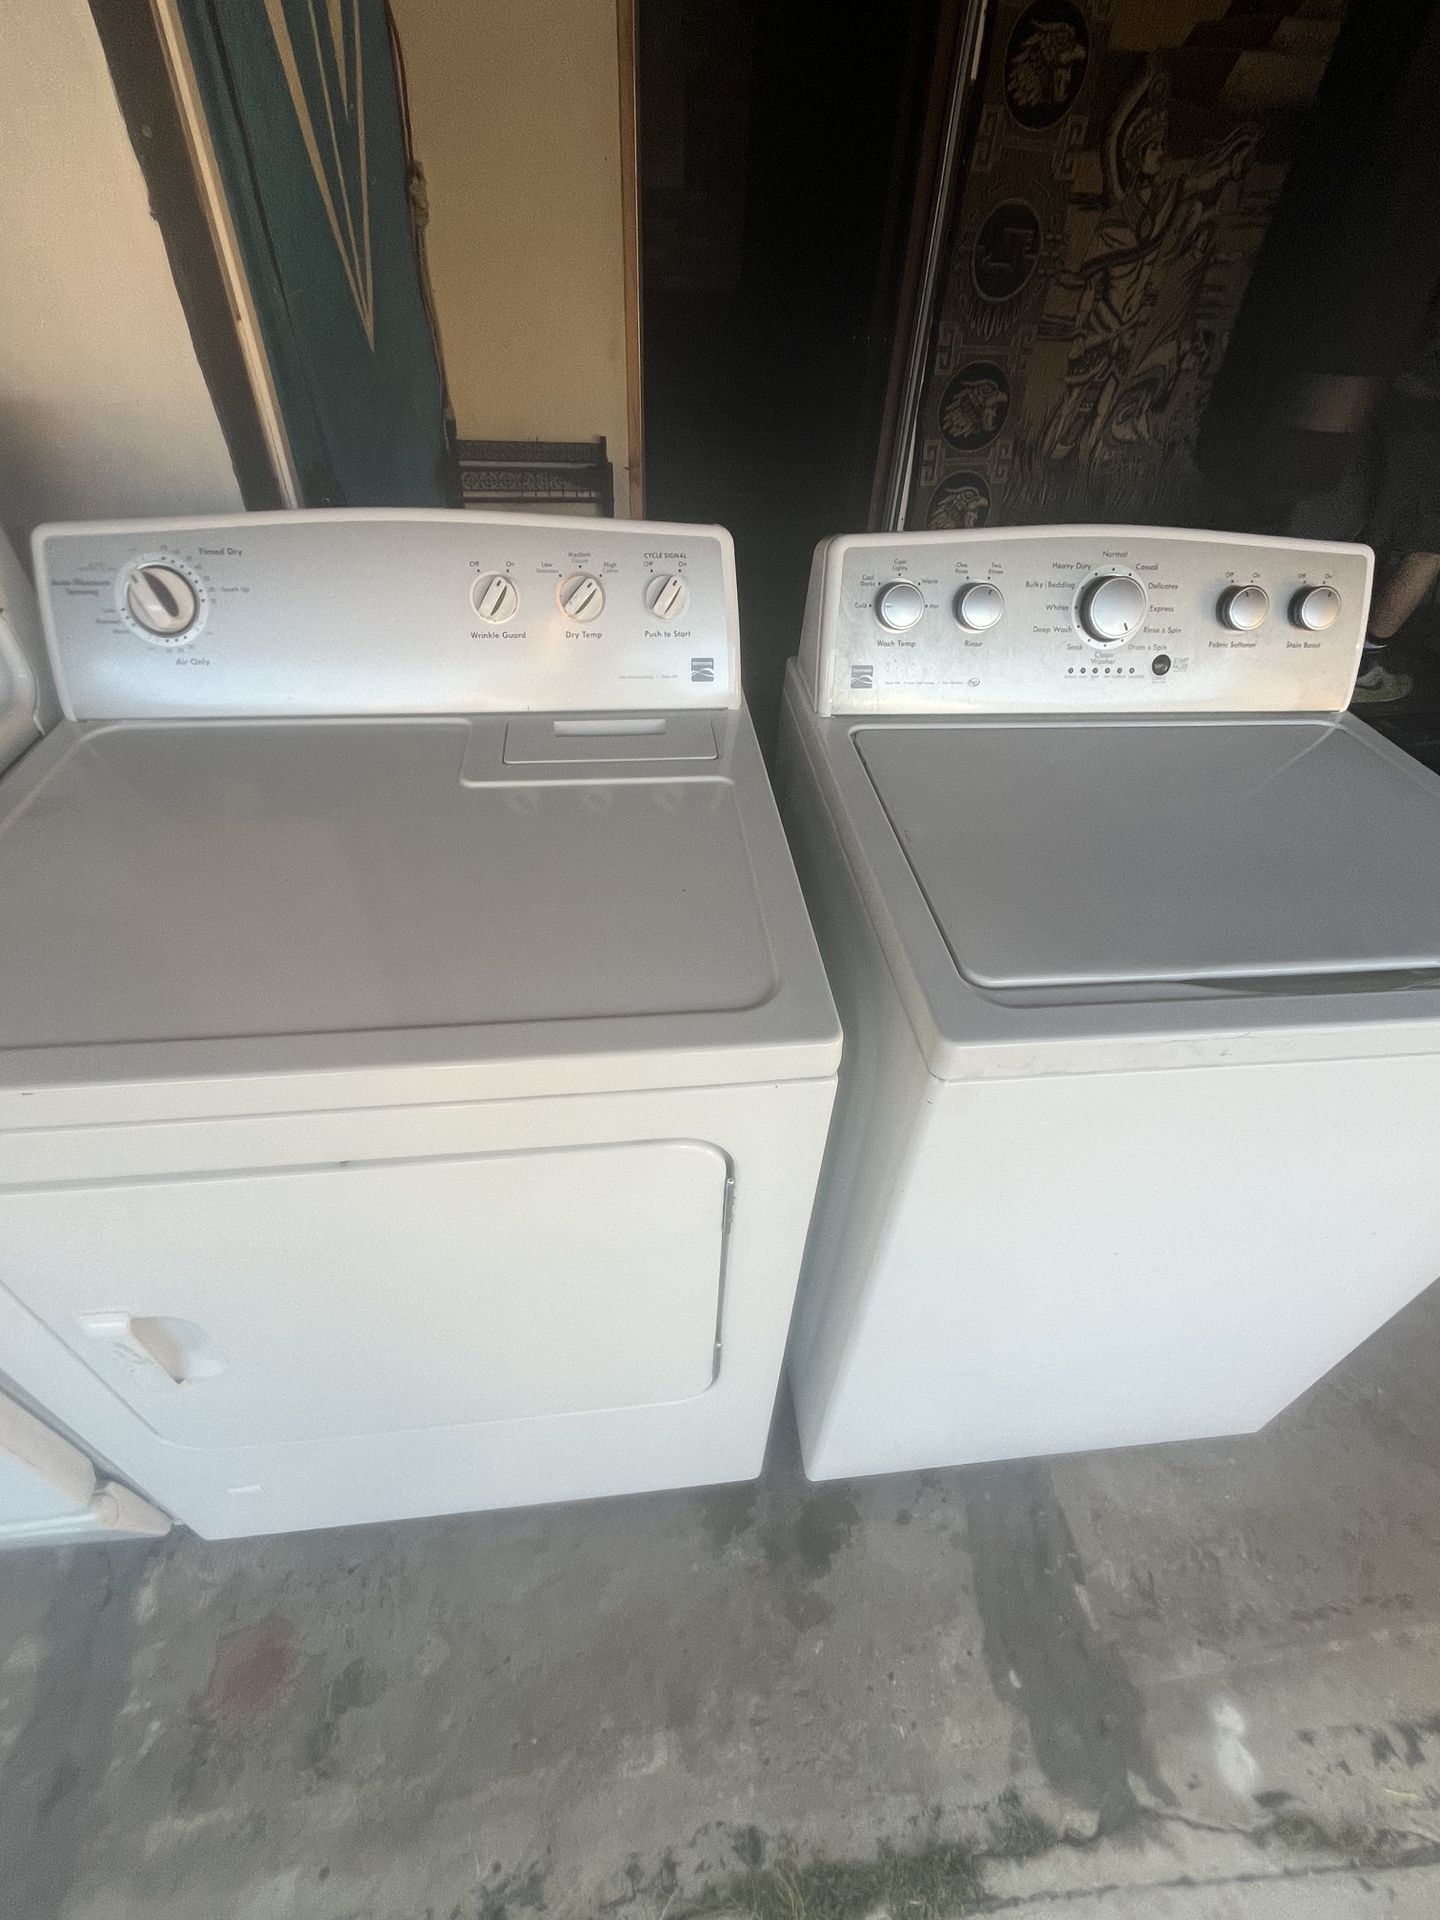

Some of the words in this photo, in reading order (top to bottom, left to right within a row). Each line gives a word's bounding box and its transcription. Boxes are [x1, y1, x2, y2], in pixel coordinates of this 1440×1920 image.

[199, 547, 225, 556] Timed
[227, 547, 243, 557] Dry
[1052, 562, 1073, 570] Heavy
[1076, 562, 1092, 570] Duty
[1135, 563, 1158, 571] Casual
[1025, 581, 1043, 589] Bulky
[1047, 581, 1075, 590] Bedding
[1148, 582, 1178, 590] Delicates
[1149, 605, 1174, 613] Express
[644, 630, 661, 638] Push
[664, 630, 671, 638] to
[1032, 626, 1051, 634] Deep
[1167, 626, 1181, 634] Spin
[470, 631, 499, 639] Wrinkle
[502, 631, 526, 639] Guard
[565, 631, 579, 639] Dry
[582, 631, 603, 639] Temp
[897, 640, 916, 648] Temp
[175, 657, 189, 666] Air
[190, 656, 210, 667] Only
